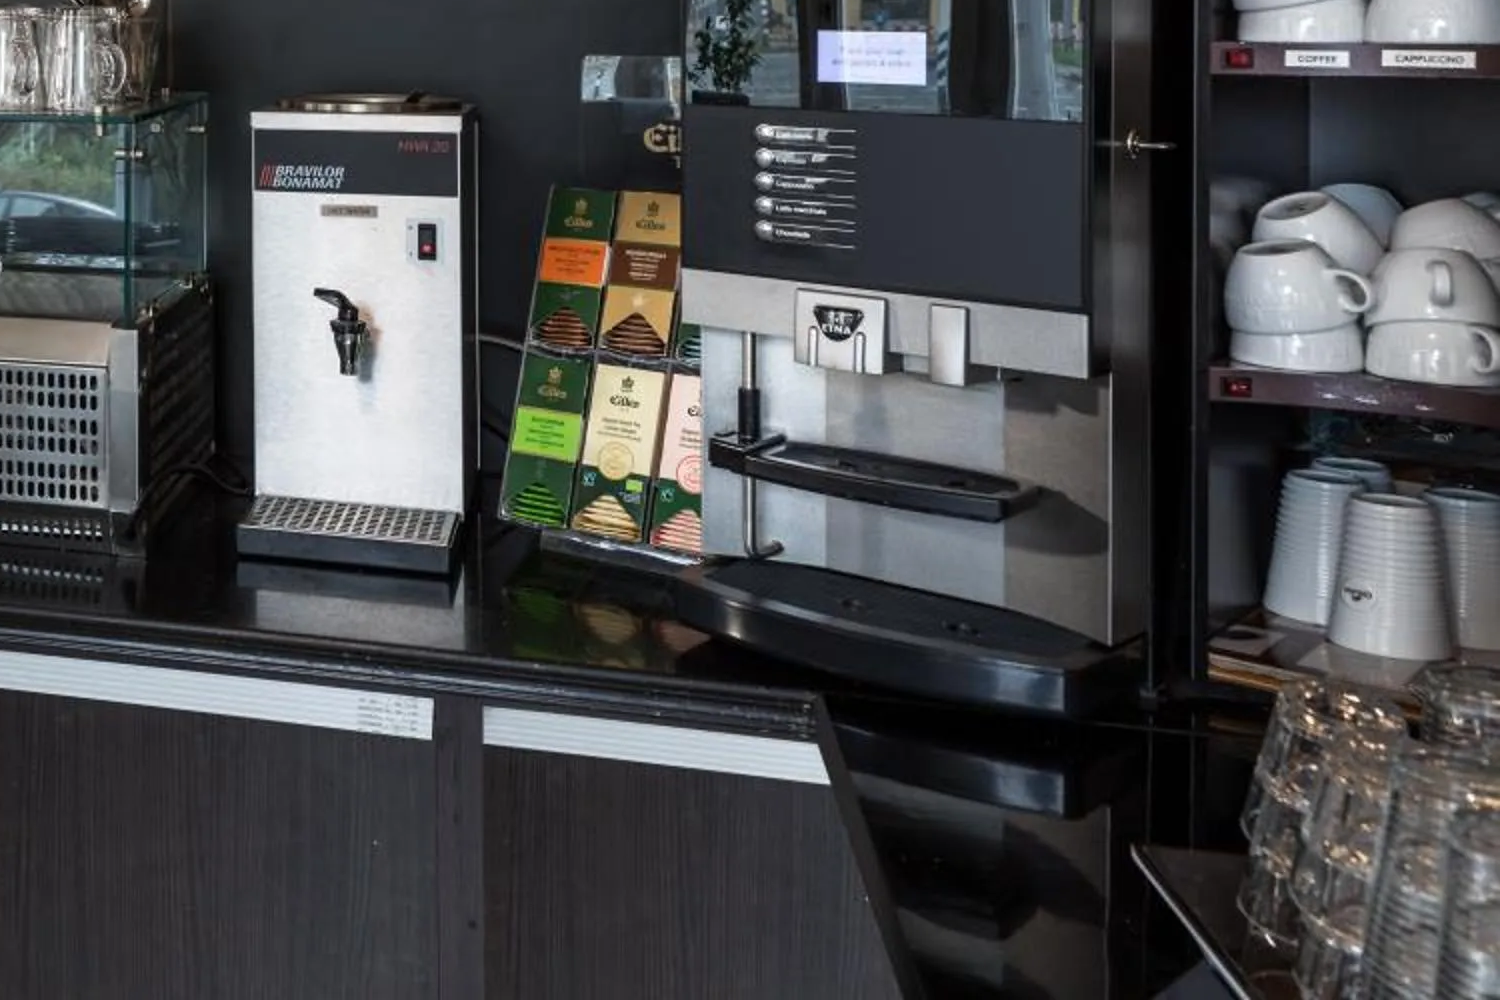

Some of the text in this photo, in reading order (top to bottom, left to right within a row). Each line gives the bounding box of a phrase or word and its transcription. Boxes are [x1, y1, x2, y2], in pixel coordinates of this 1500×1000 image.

[1297, 54, 1465, 66] COFFEE CAPPUCCINO
[275, 165, 345, 178] BRAVILOR
[272, 177, 343, 189] BONAMAT
[821, 323, 852, 335] ETNA
